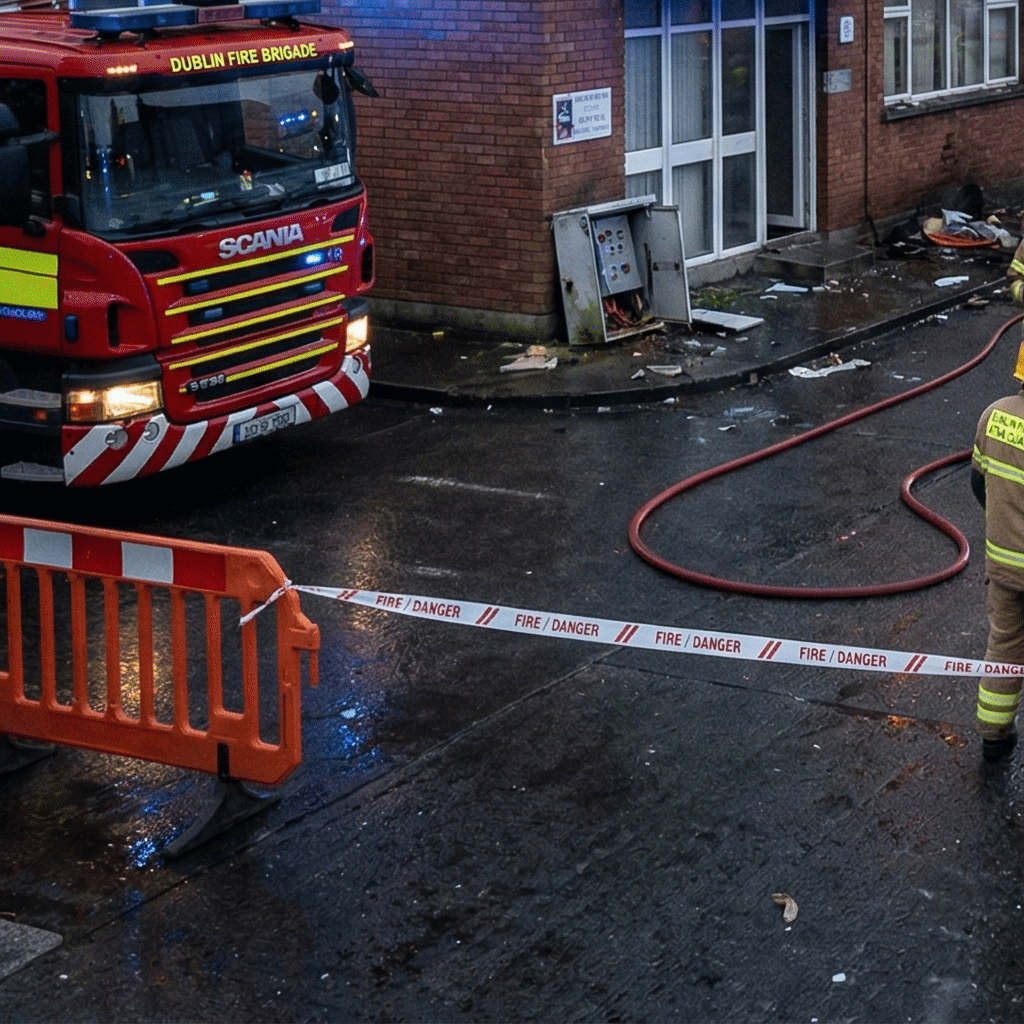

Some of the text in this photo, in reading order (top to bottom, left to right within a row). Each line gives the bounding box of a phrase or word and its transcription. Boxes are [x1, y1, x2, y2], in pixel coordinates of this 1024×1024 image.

[170, 42, 318, 73] DUBLIN FIRE BRIGADE
[218, 223, 305, 259] SCANIA
[375, 595, 404, 609] FIRE
[412, 600, 461, 618] DANGER
[514, 614, 542, 629] FIRE
[551, 619, 600, 637] DANGER
[655, 631, 682, 647] FIRE
[692, 636, 741, 654] DANGER
[799, 646, 827, 662] FIRE
[837, 651, 887, 668] DANGER
[944, 661, 972, 673] FIRE
